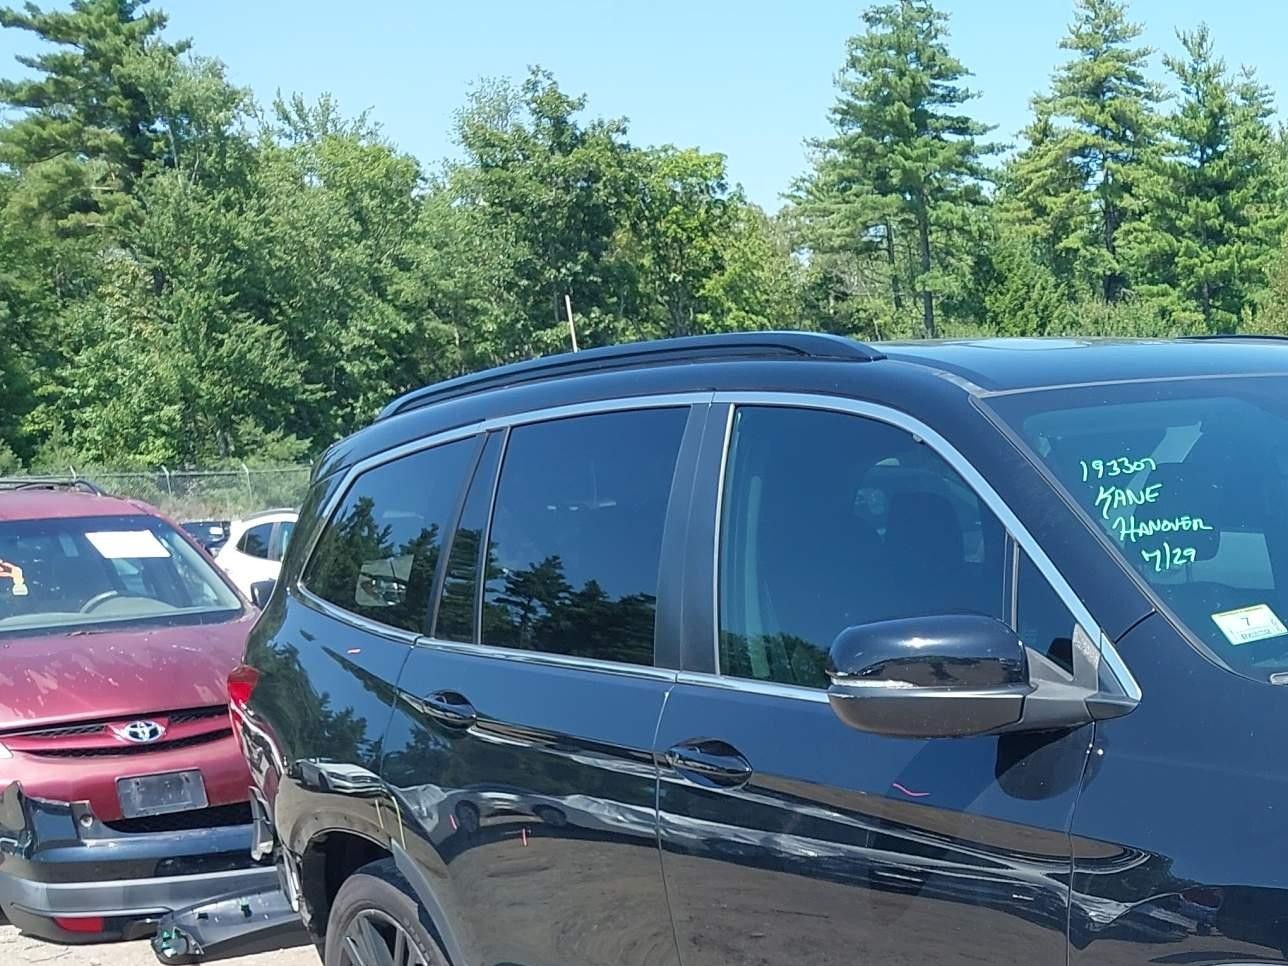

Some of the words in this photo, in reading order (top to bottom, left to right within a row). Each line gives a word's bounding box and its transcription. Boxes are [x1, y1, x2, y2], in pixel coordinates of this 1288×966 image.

[1080, 457, 1156, 482] 193307
[1094, 483, 1163, 520] KANE
[1112, 515, 1213, 542] HANOVER
[1141, 541, 1196, 572] 7/29
